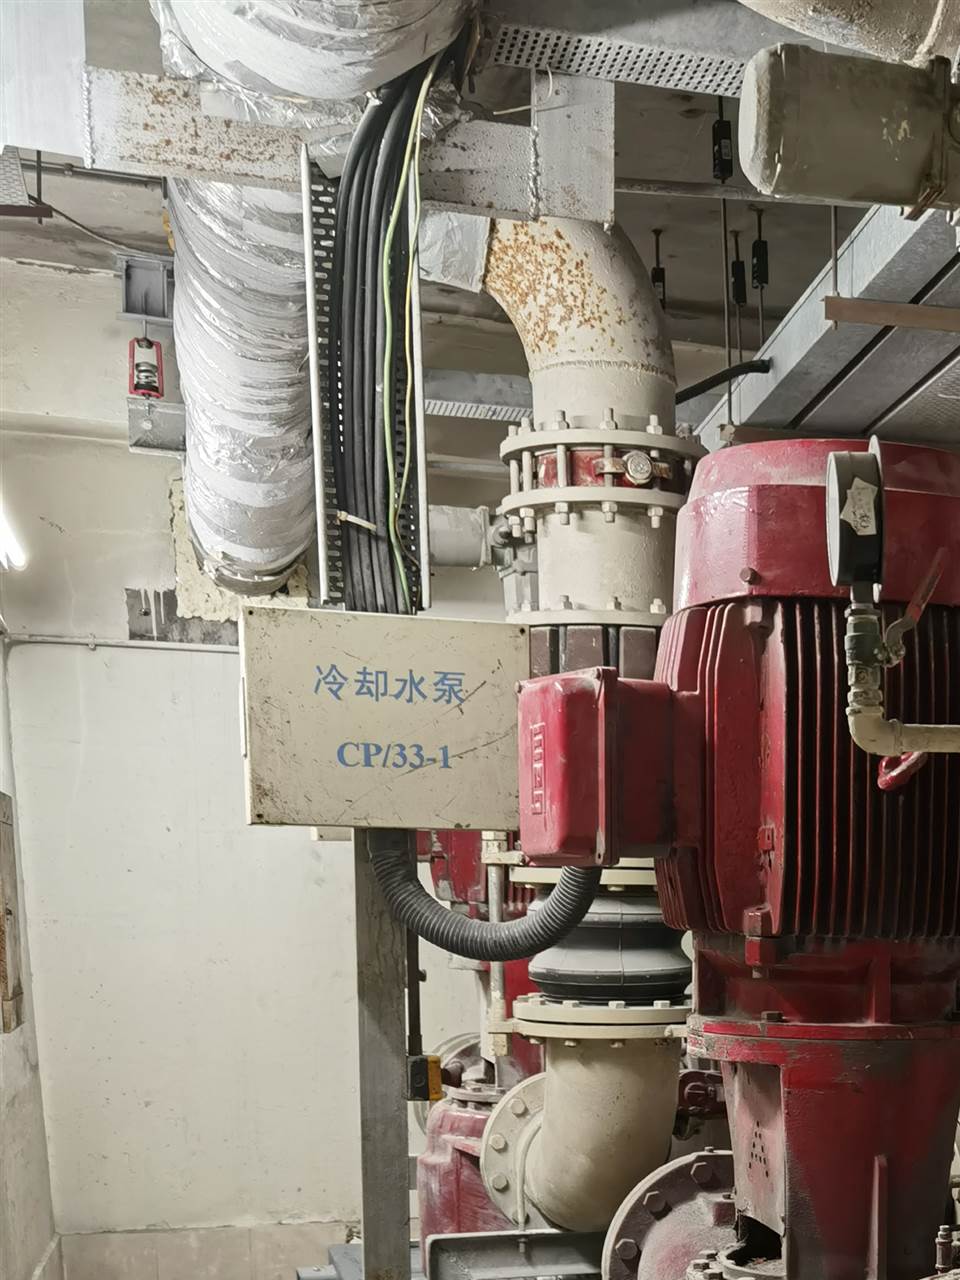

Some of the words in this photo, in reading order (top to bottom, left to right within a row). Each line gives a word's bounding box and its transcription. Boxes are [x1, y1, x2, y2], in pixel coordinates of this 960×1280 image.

[314, 664, 466, 704] 冷却水泵
[336, 742, 452, 770] CP/33-1
